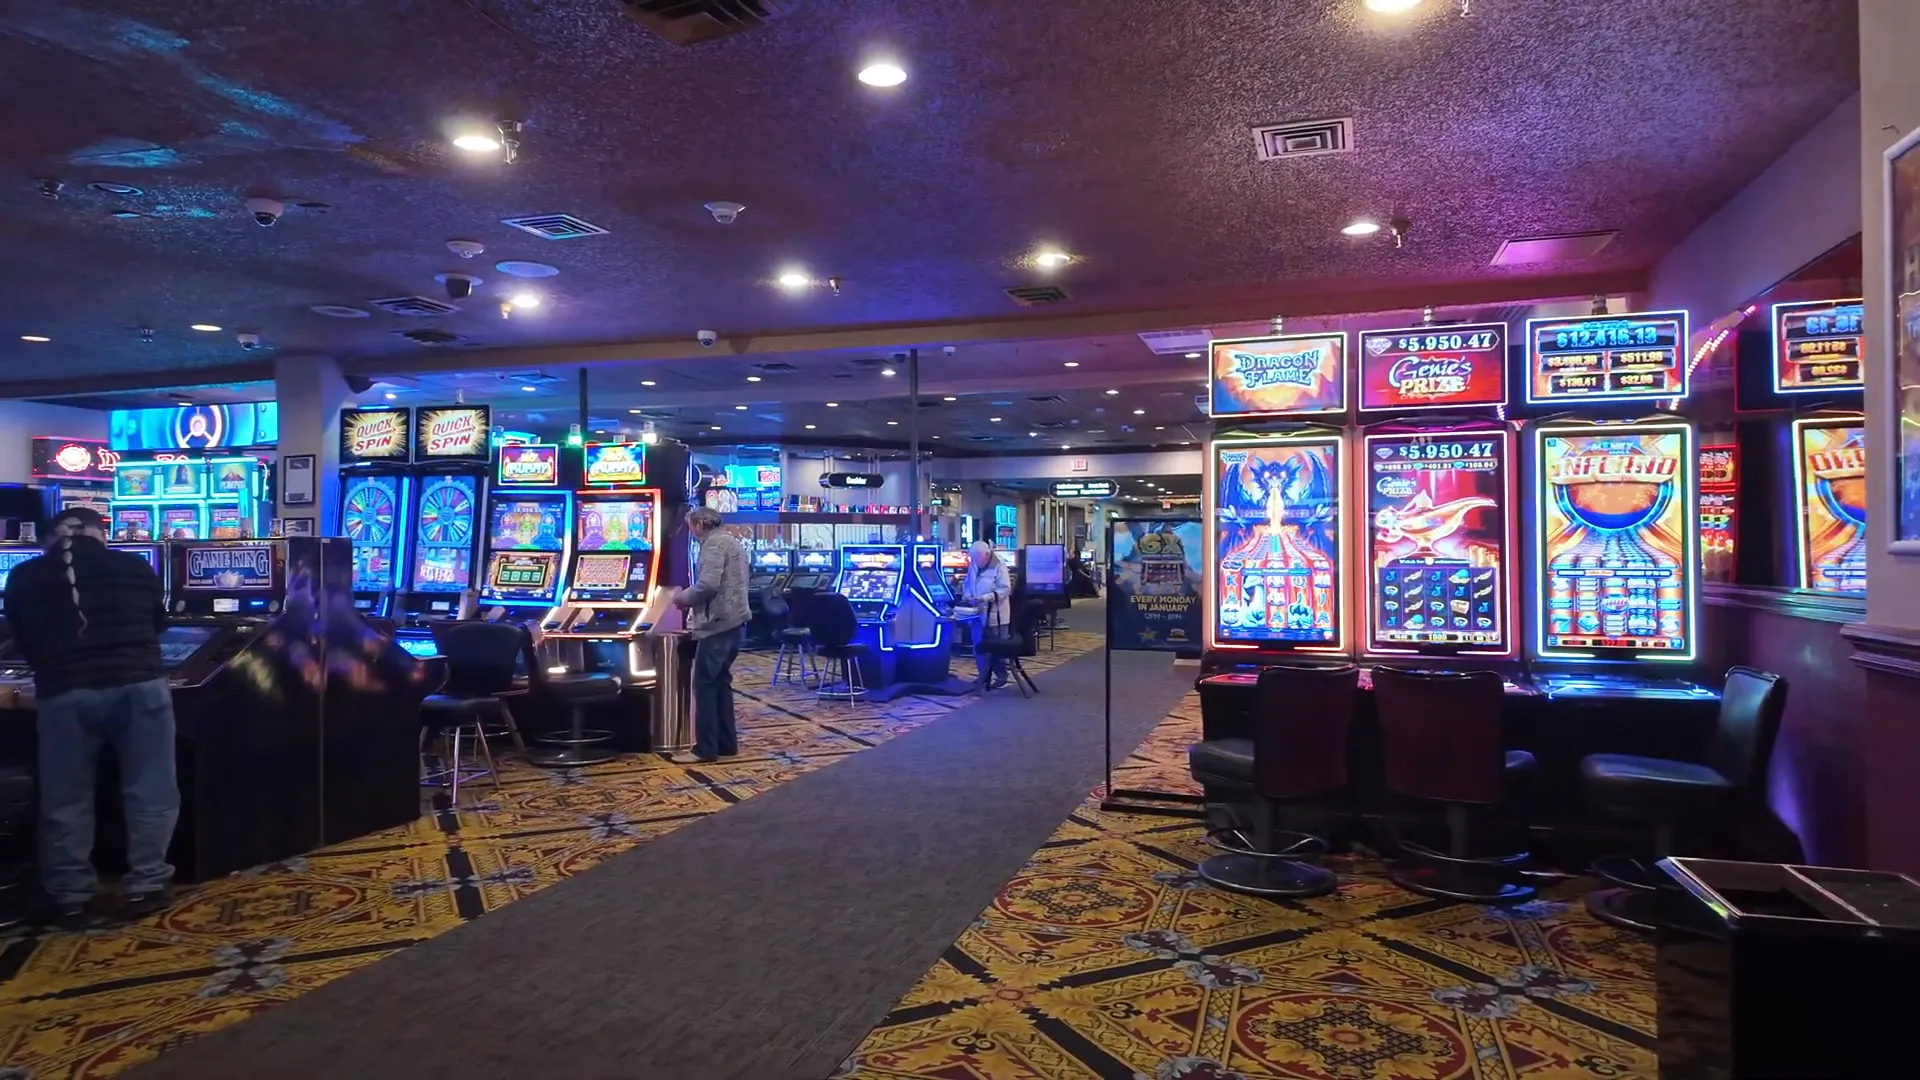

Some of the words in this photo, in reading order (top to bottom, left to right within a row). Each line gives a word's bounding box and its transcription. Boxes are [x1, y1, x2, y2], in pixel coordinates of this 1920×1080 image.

[1234, 349, 1319, 372] DRAGON
[1244, 368, 1312, 388] FLAME
[1388, 356, 1472, 388] Genie's
[1398, 376, 1467, 395] PRIZE
[356, 418, 394, 438] QUICK
[433, 415, 473, 436] QUICK
[354, 436, 392, 451] SPIN
[430, 434, 471, 451] SPIN
[1555, 456, 1678, 476] INFERNO
[1139, 533, 1184, 555] 6X
[190, 551, 230, 577] GAME
[231, 550, 269, 577] KING
[1130, 595, 1158, 603] EVERY
[1159, 596, 1196, 604] MONDAY
[1138, 603, 1147, 611] IN
[1149, 604, 1189, 612] JANUARY
[1144, 613, 1161, 621] 12PM
